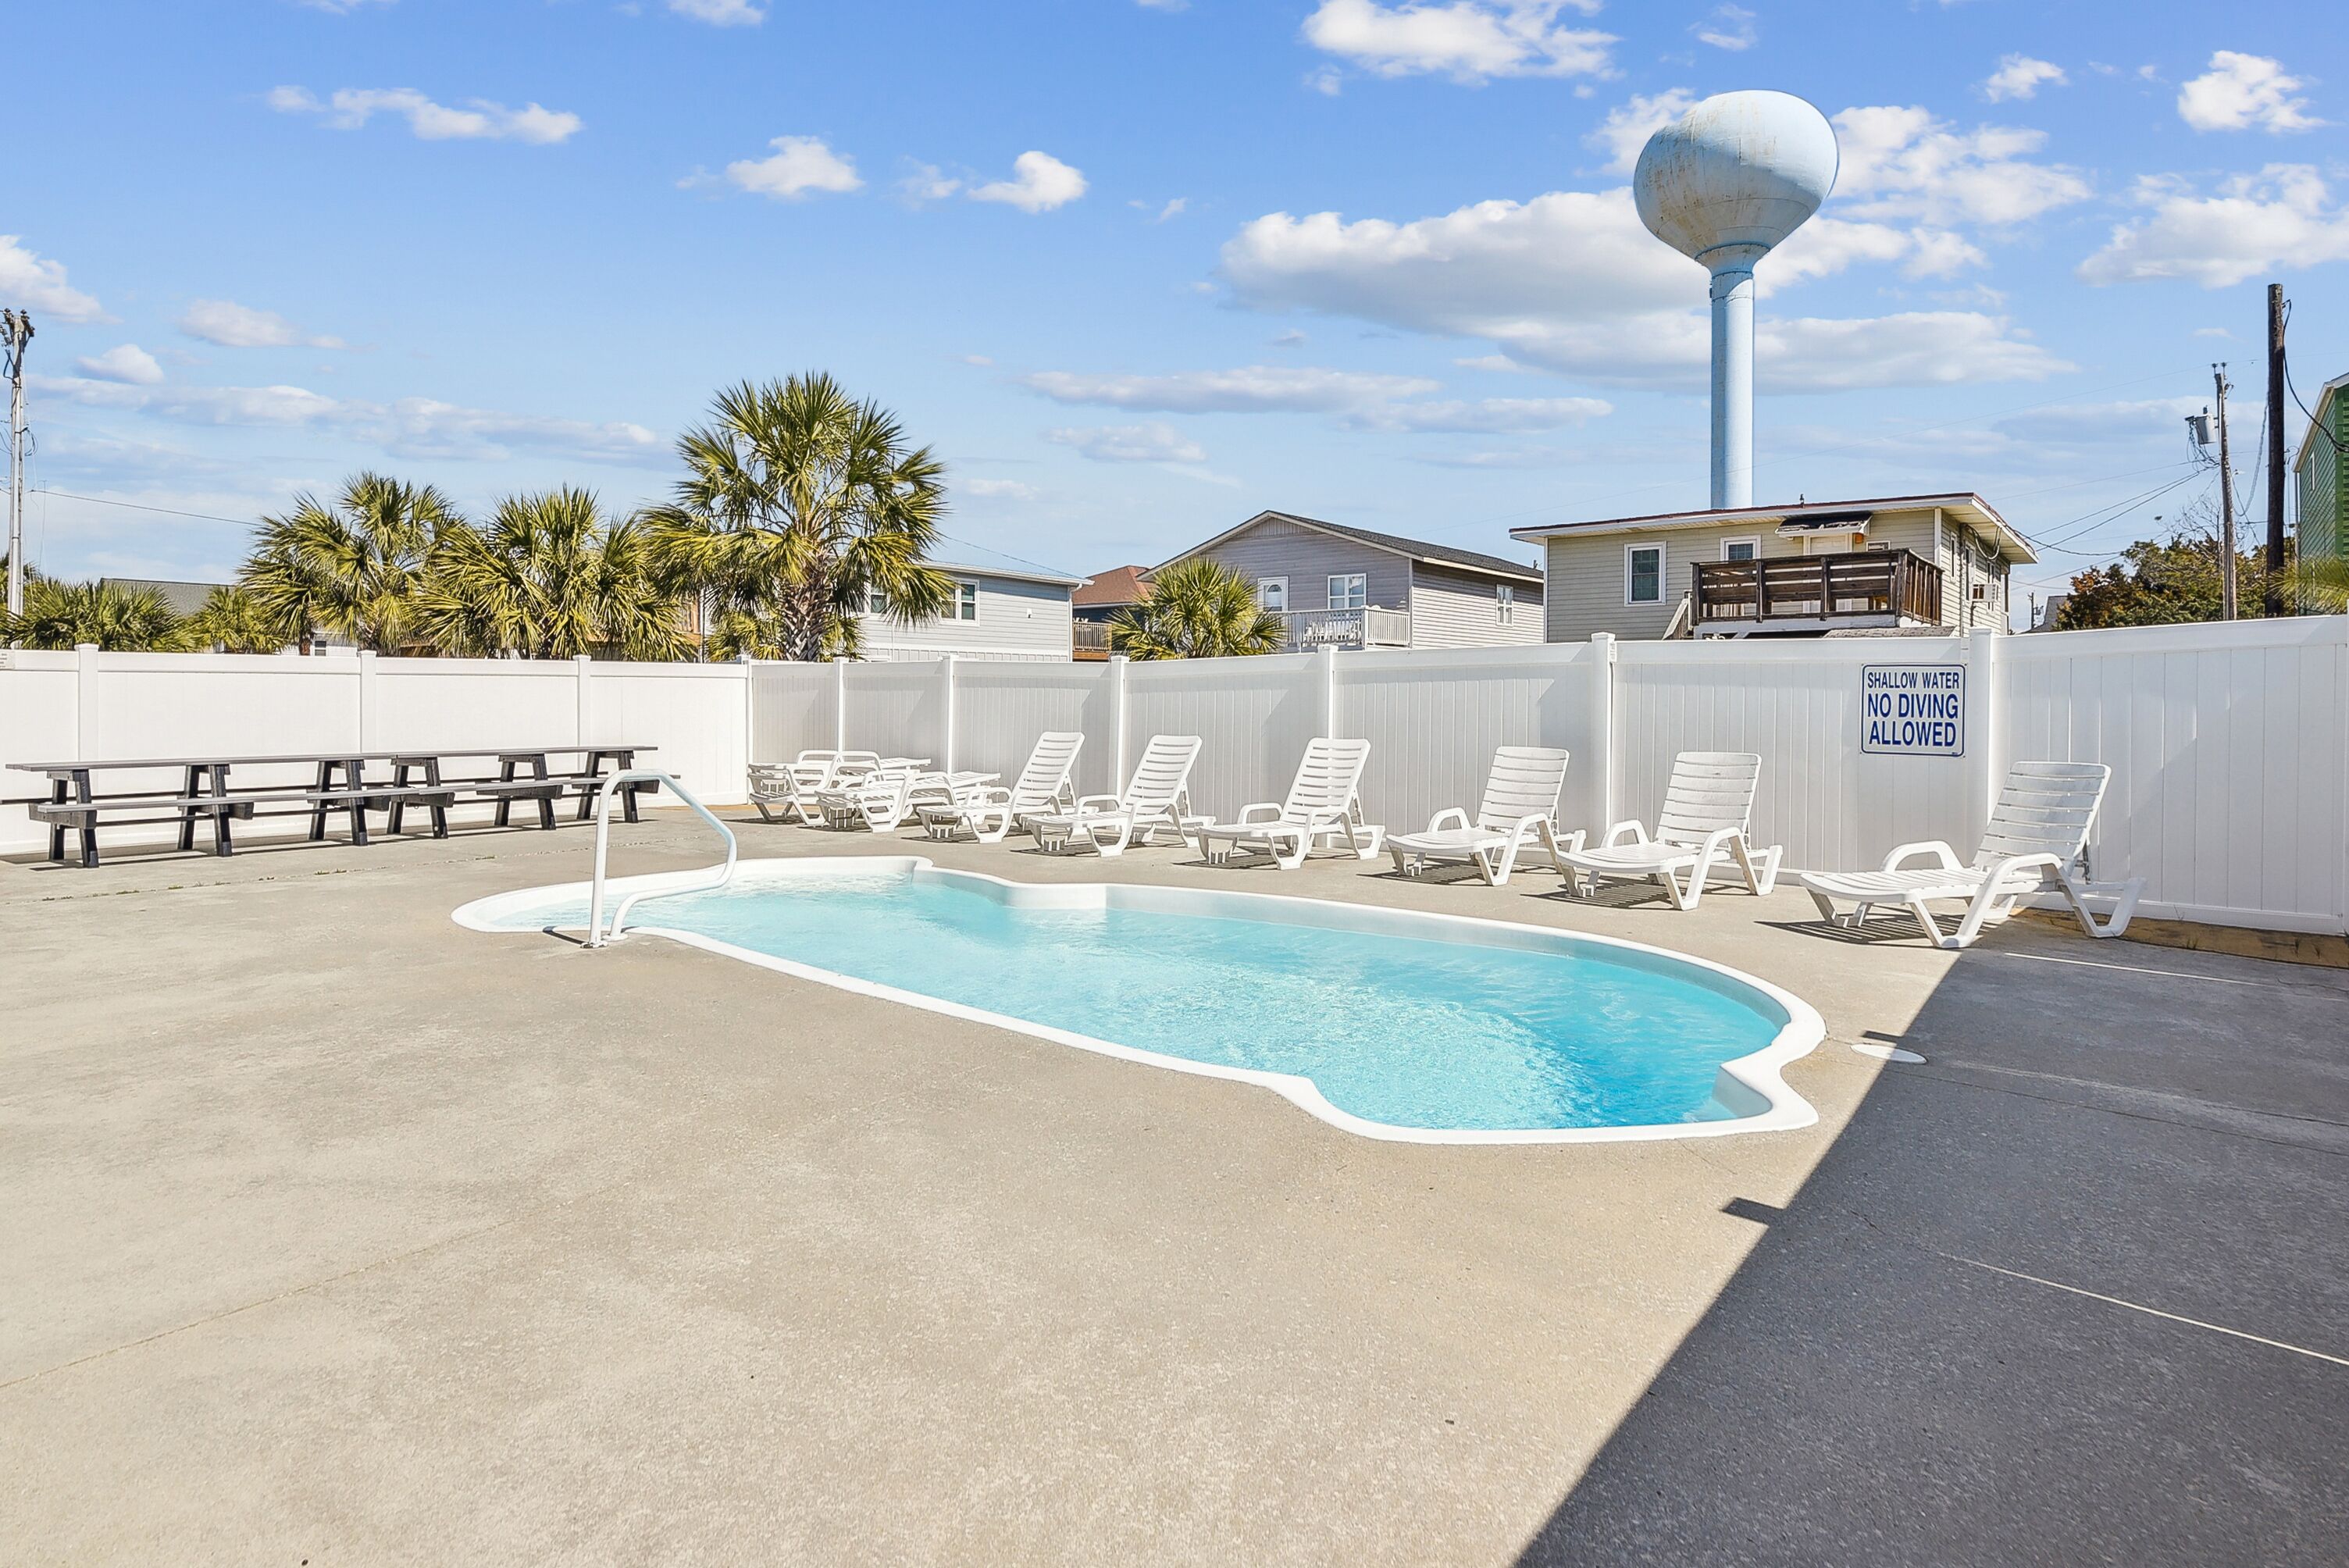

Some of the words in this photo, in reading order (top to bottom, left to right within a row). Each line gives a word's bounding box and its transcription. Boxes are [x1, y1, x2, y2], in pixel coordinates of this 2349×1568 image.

[1867, 672, 1918, 689] SHALLOW
[1922, 672, 1959, 689] WATER
[1868, 693, 1891, 718] NO
[1898, 693, 1958, 718] DIVING
[1869, 721, 1955, 747] ALLOWED
